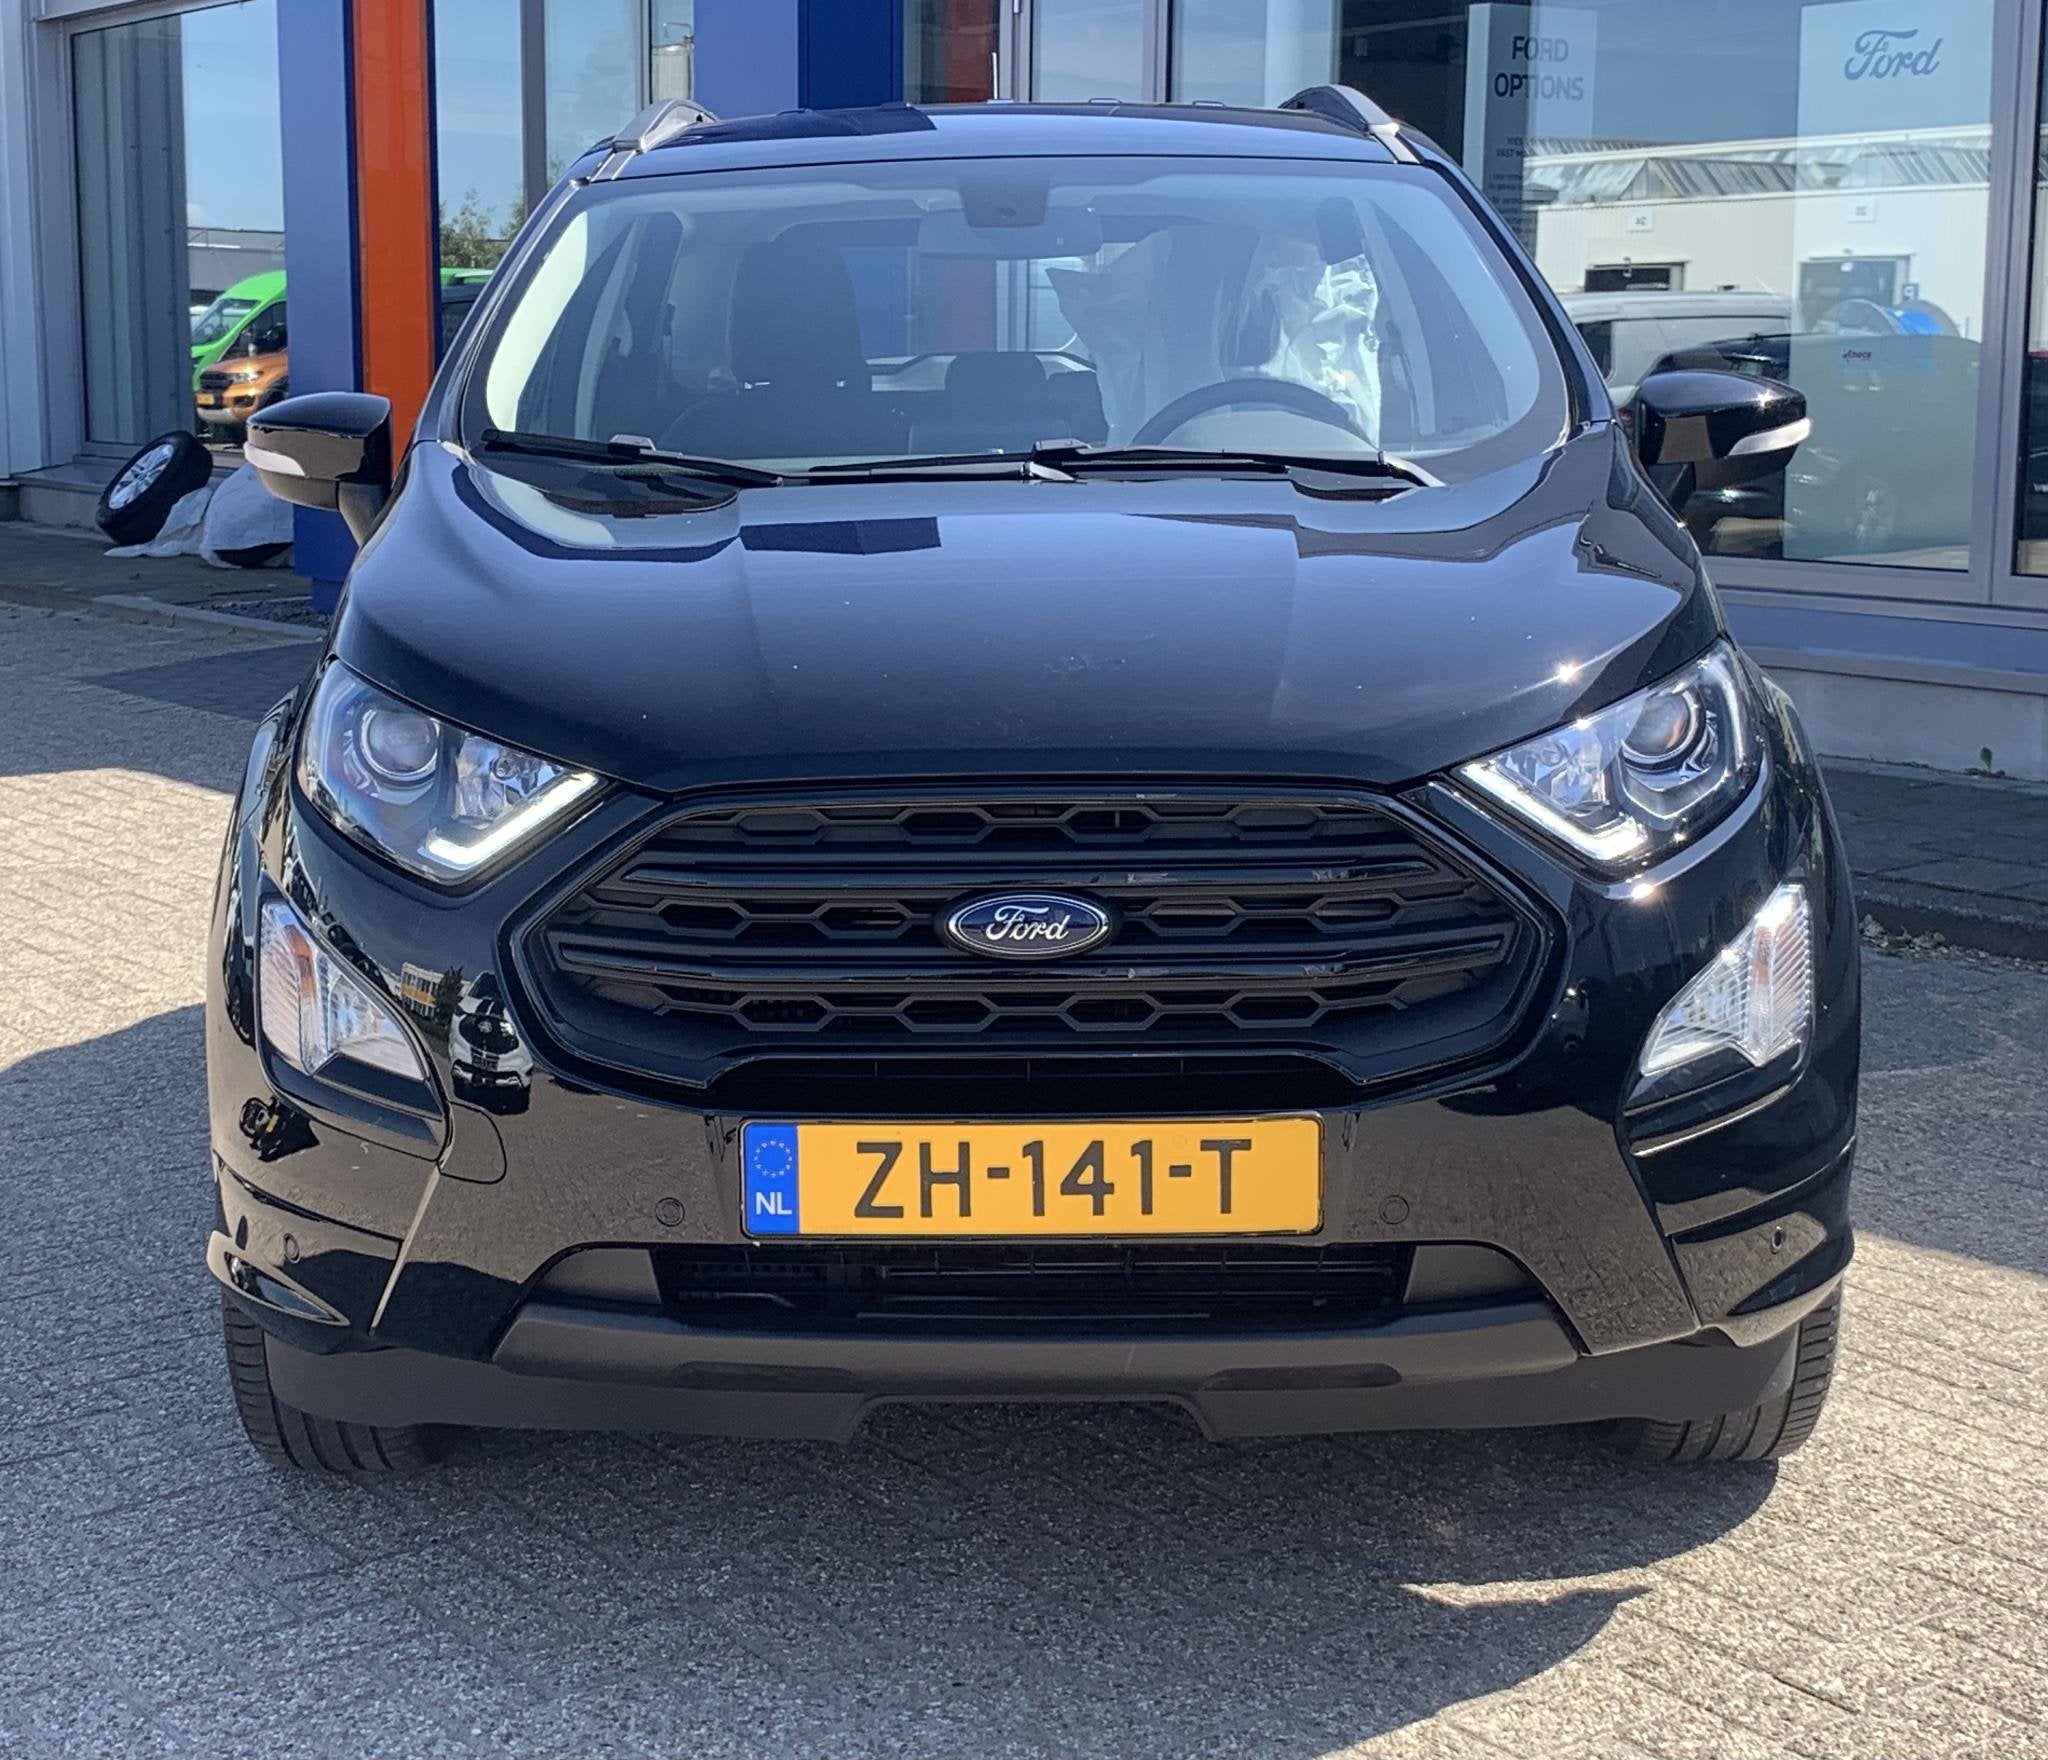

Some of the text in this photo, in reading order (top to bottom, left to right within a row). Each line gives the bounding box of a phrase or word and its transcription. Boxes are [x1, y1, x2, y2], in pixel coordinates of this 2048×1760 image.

[1512, 36, 1568, 62] FORD
[1844, 28, 1943, 81] Ford
[1494, 73, 1583, 101] OPTIONS
[986, 905, 1071, 940] Ford
[854, 1139, 1252, 1218] ZH-141-T
[756, 1191, 793, 1215] NL
